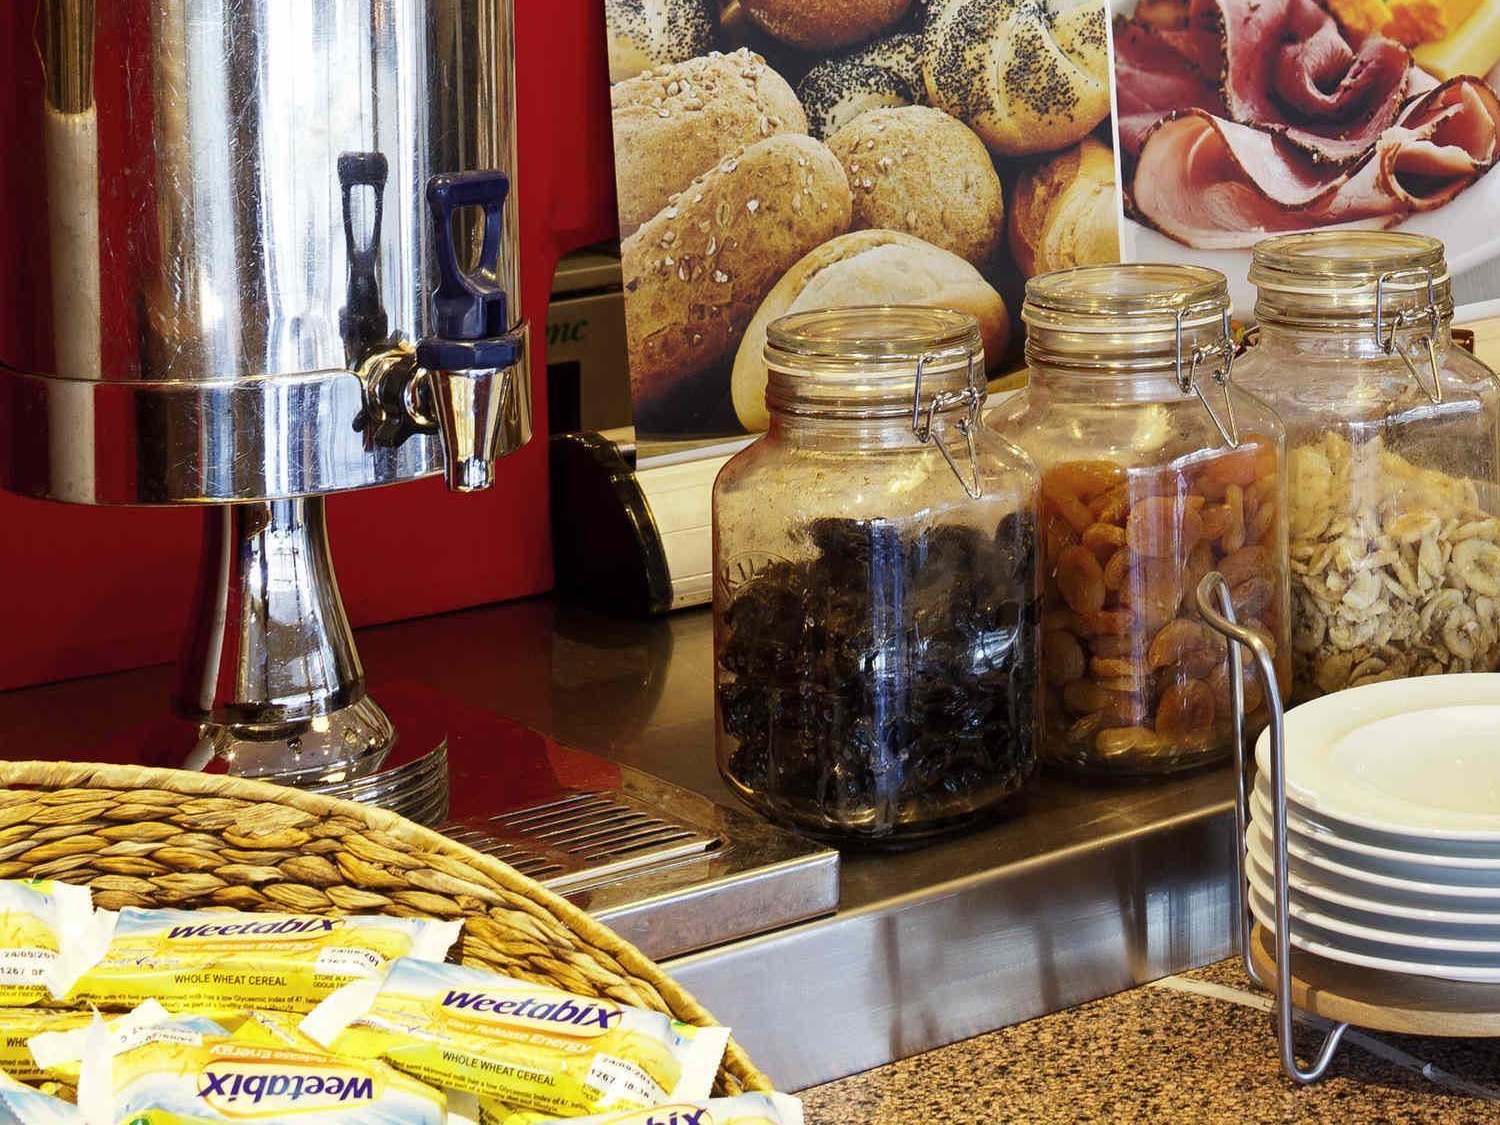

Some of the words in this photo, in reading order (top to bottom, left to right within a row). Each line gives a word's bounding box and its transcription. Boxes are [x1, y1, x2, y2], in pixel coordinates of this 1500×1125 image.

[167, 917, 342, 939] Weetabix
[174, 974, 211, 984] WHOLE
[213, 975, 246, 985] WHEAT
[248, 975, 287, 987] CEREAL
[441, 990, 625, 1029] Weetabix
[442, 1050, 478, 1068] WHOLE
[480, 1059, 515, 1077] WHEAT
[517, 1069, 556, 1087] CEREAL
[196, 1072, 374, 1104] Weetabix
